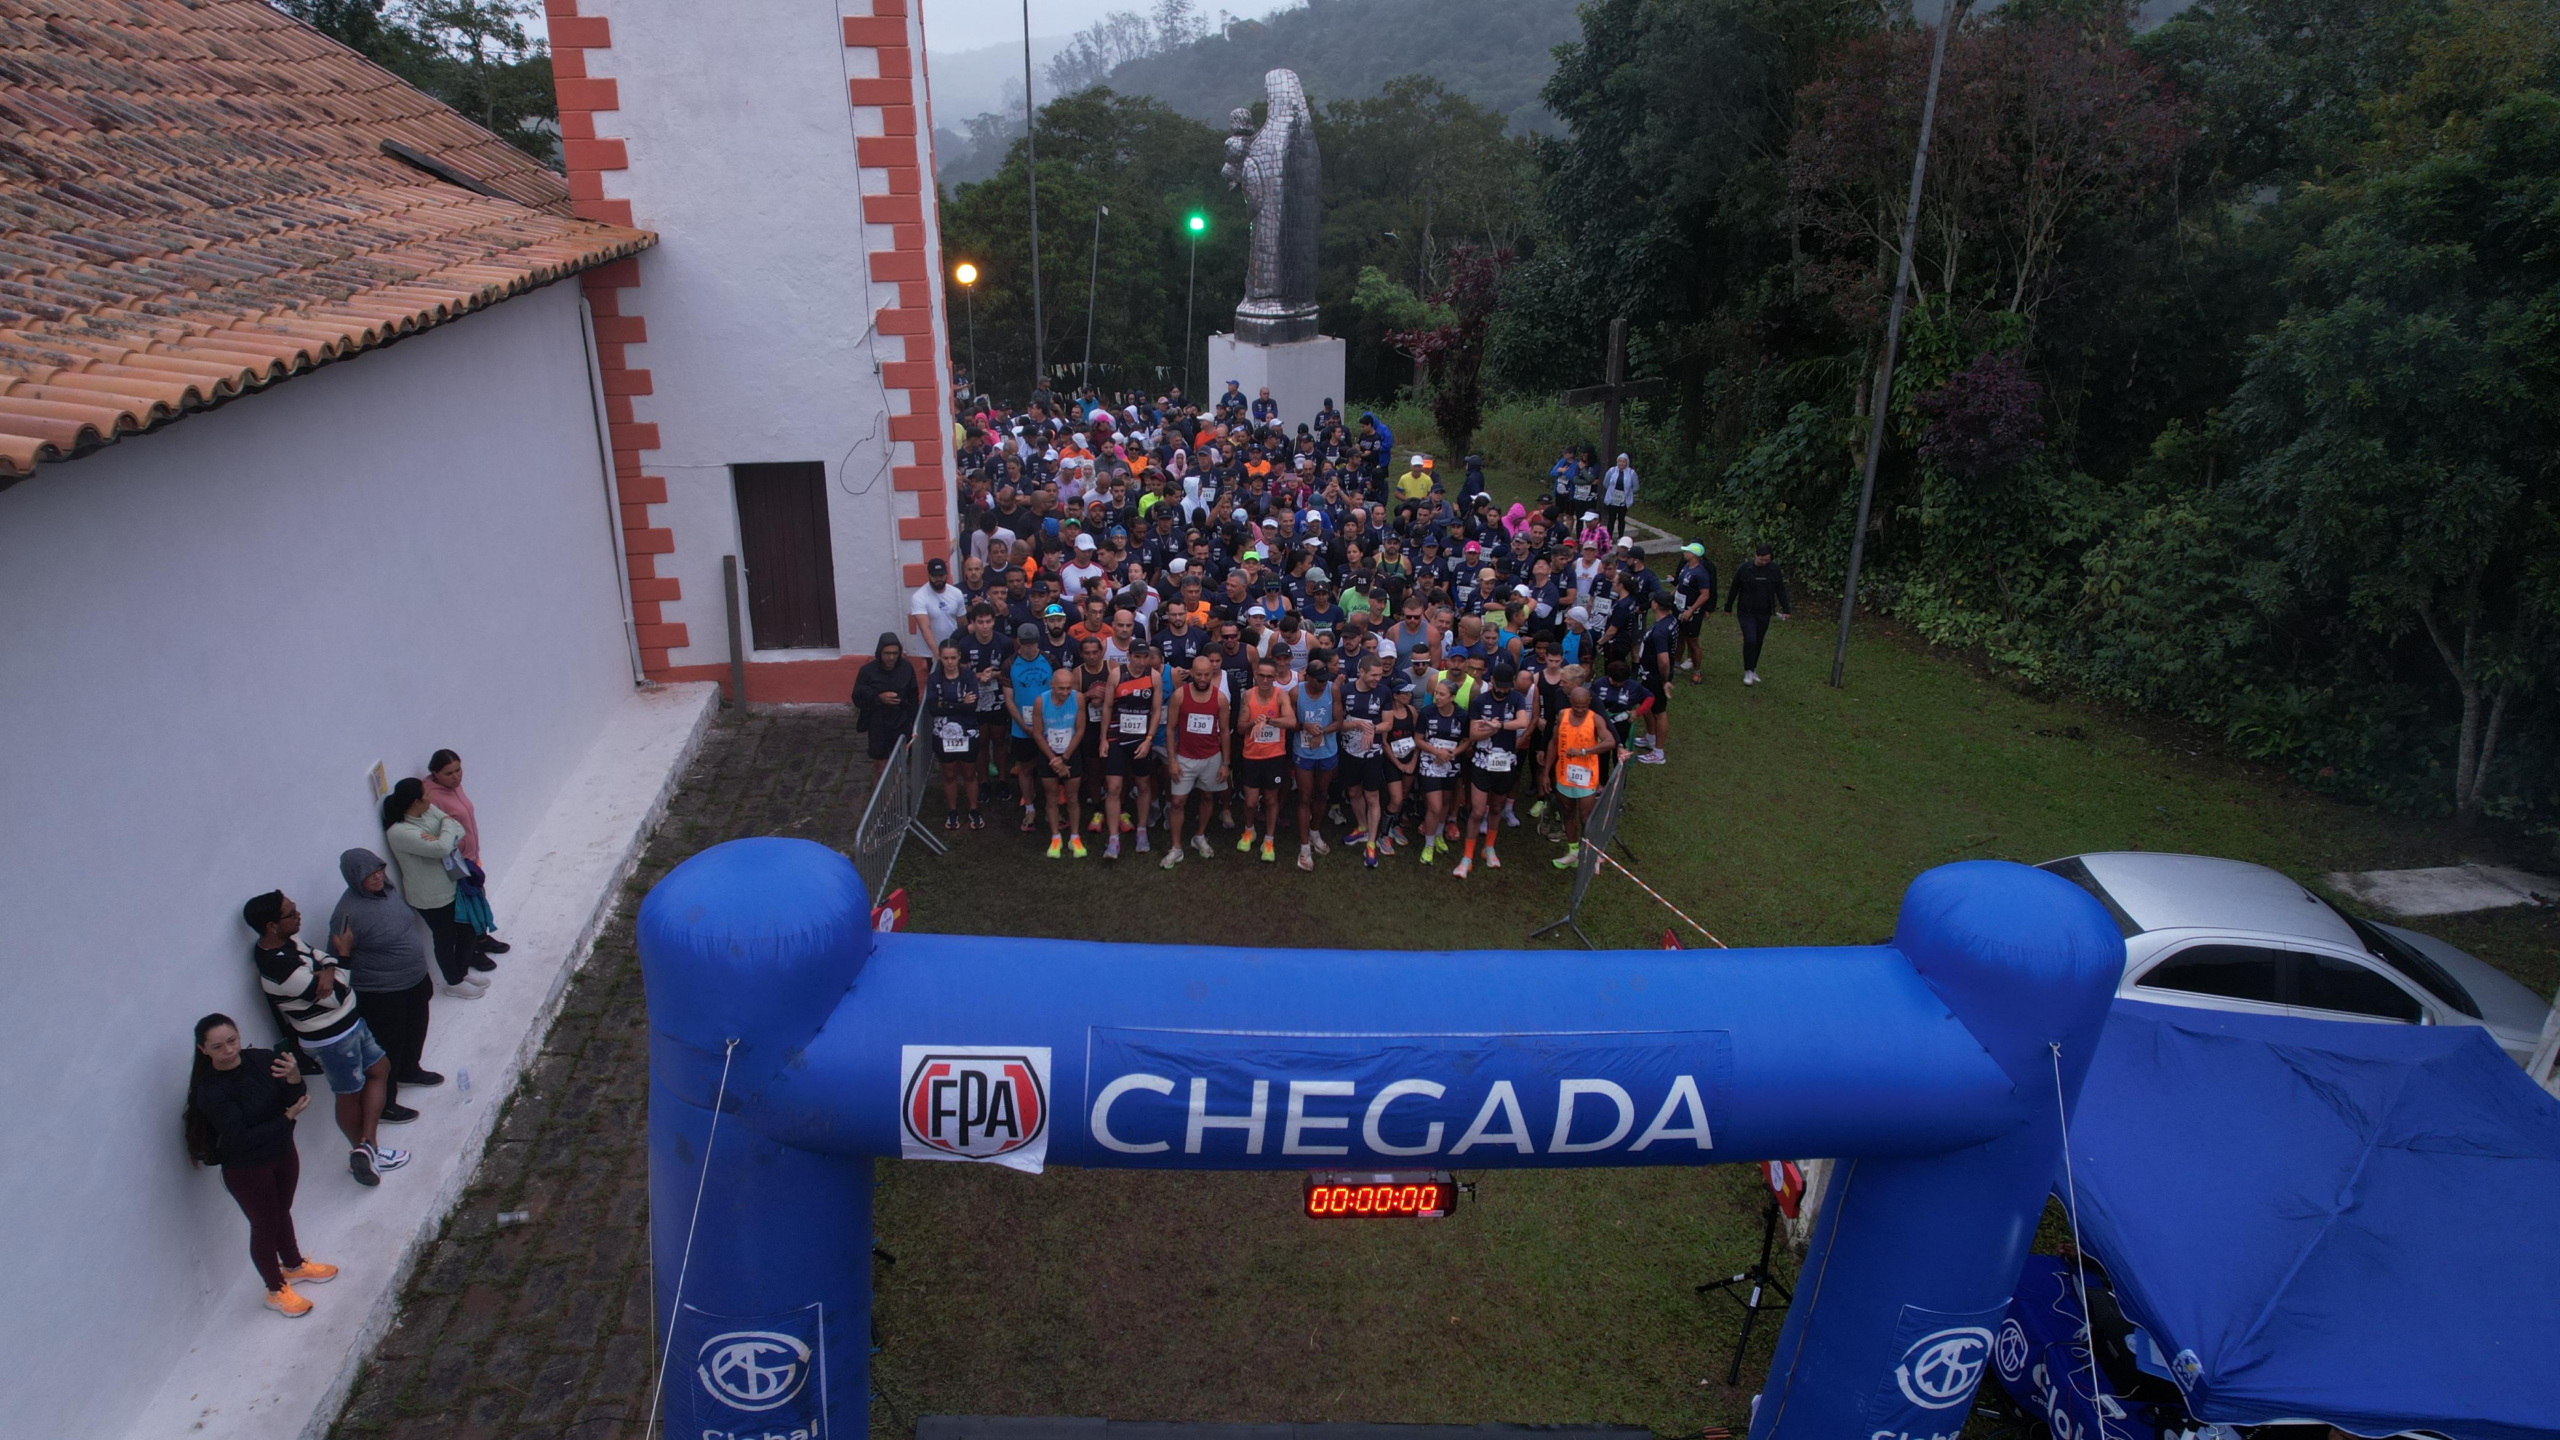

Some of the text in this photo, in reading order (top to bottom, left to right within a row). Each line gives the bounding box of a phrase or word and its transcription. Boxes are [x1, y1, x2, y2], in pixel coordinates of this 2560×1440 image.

[1193, 721, 1207, 729] 130
[1571, 772, 1583, 780] 101
[932, 1070, 1019, 1146] FPA
[1090, 1074, 1714, 1155] CHEGADA
[1311, 1187, 1437, 1212] 00:00:00
